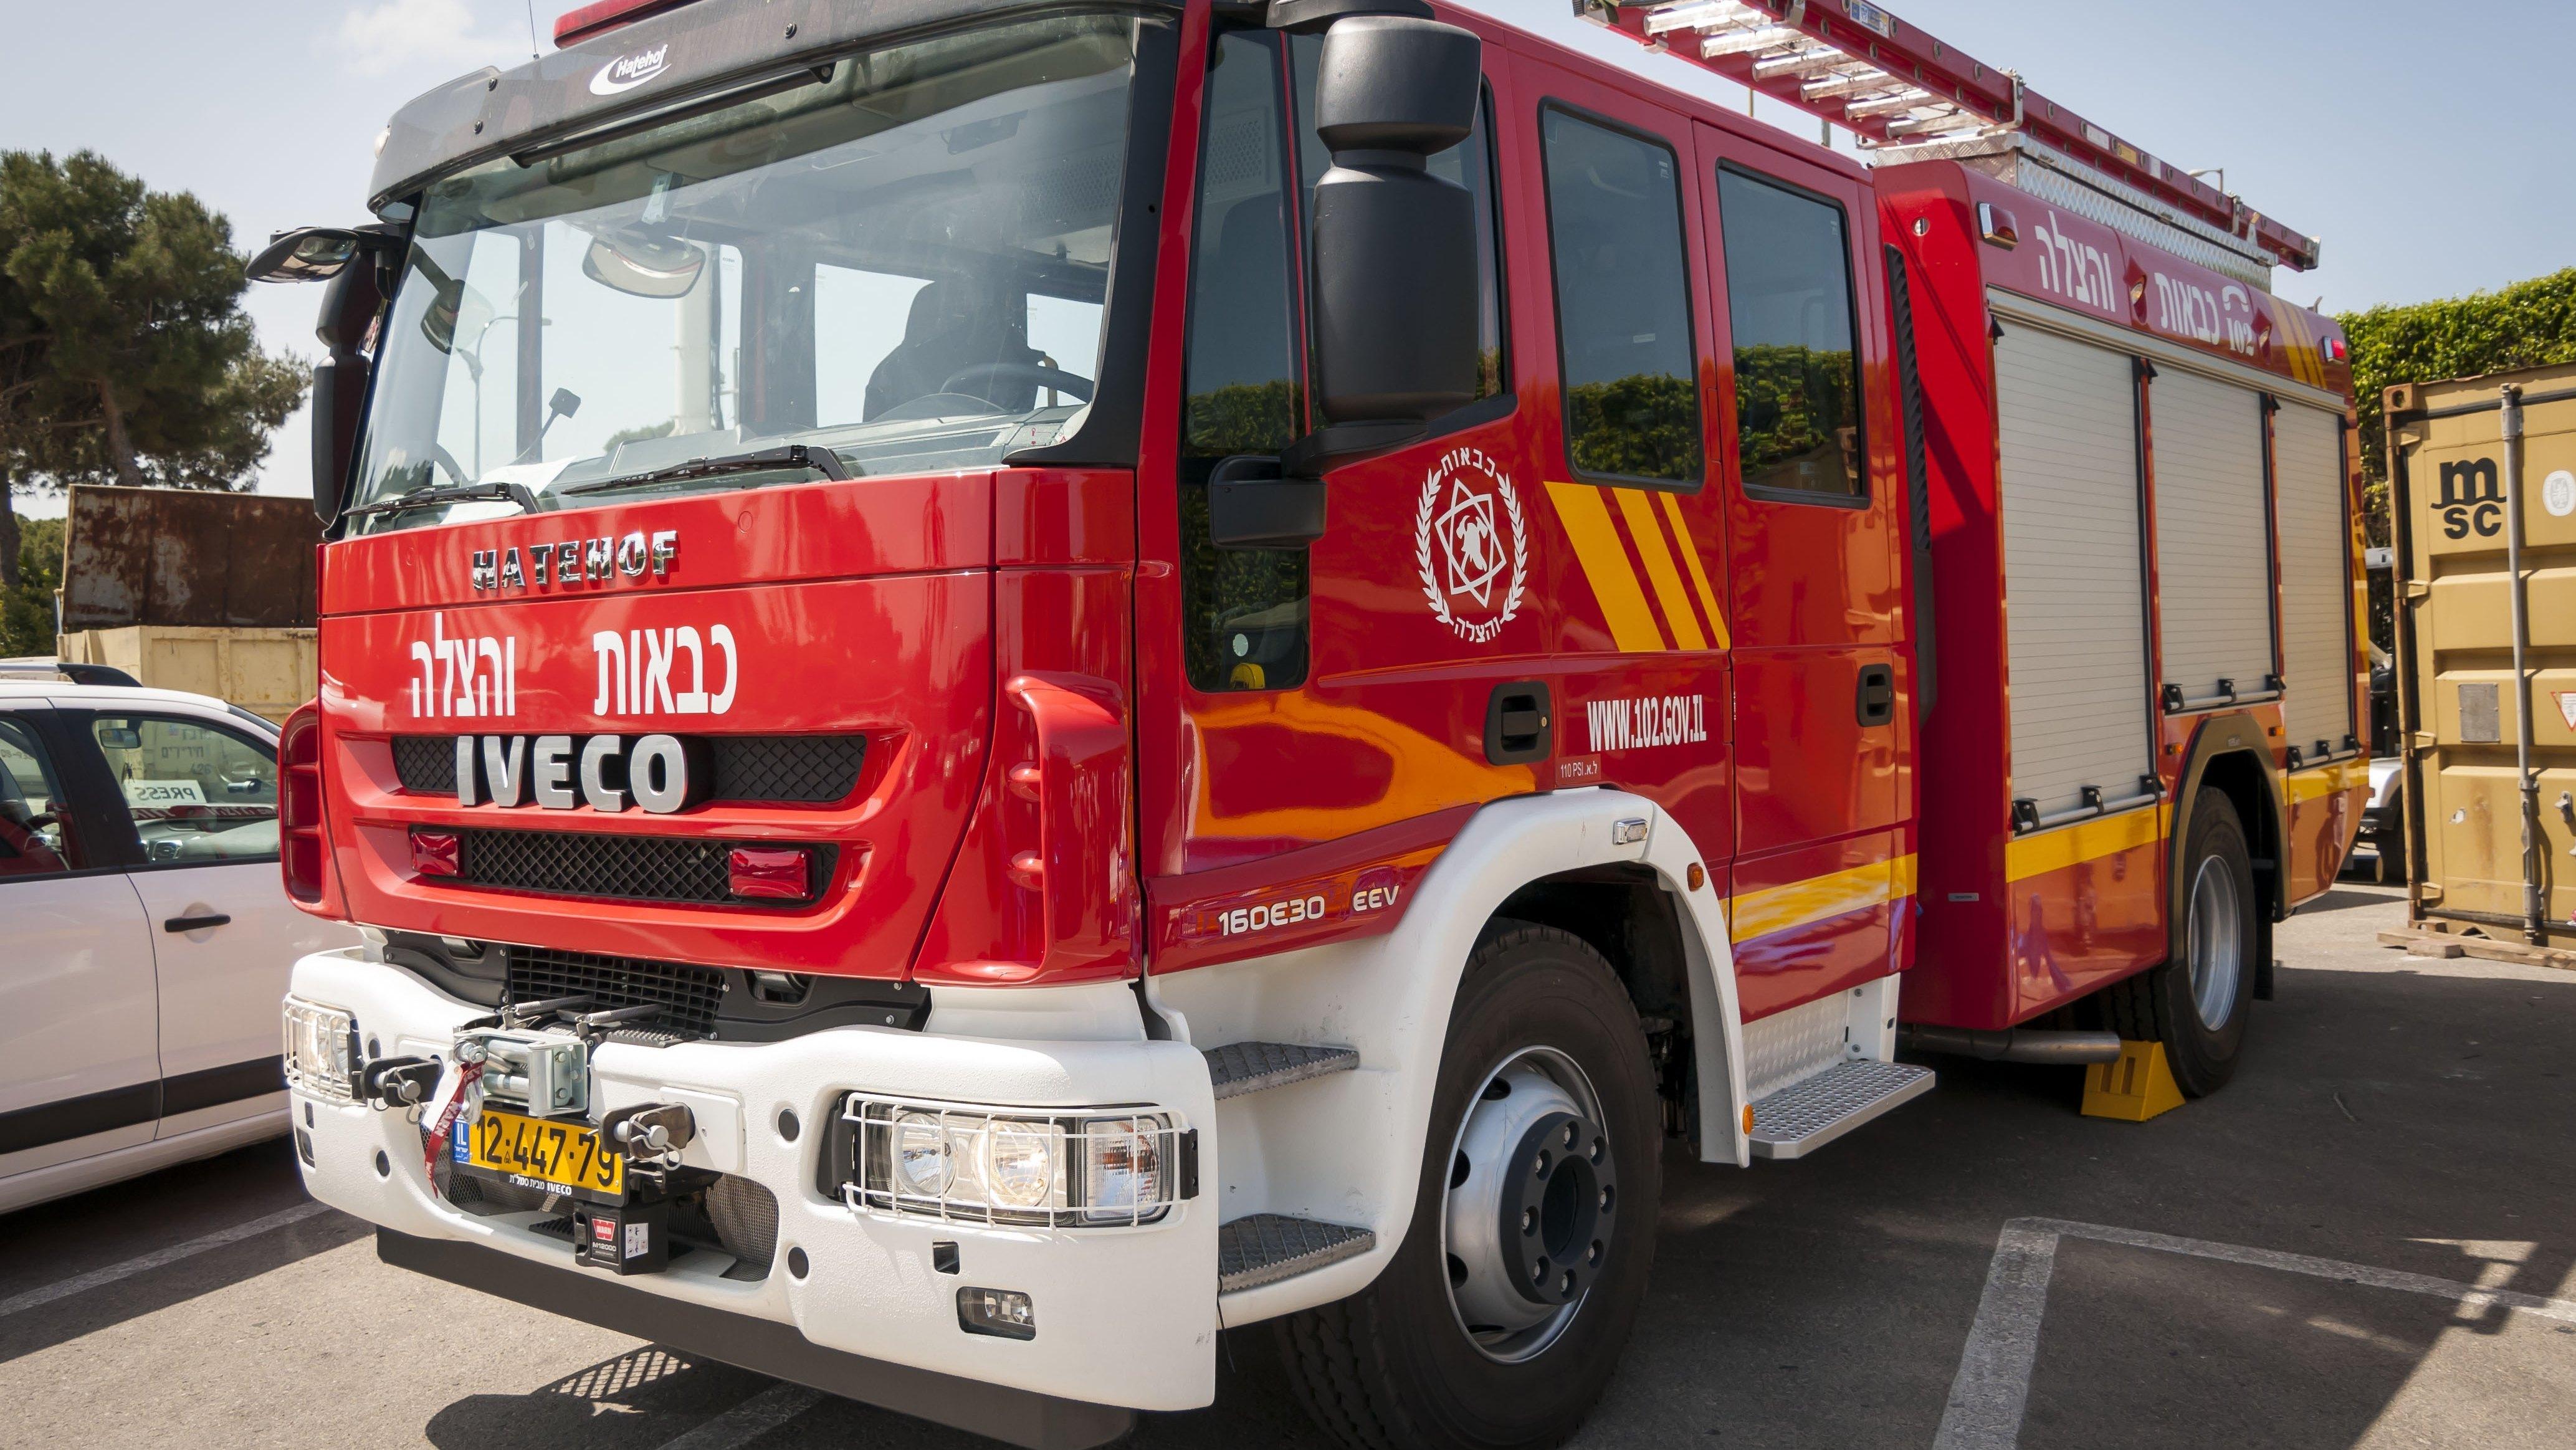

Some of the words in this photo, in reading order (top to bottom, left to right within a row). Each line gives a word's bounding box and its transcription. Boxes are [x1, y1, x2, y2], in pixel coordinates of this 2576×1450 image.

[616, 44, 669, 78] Hatehof
[2035, 210, 2116, 312] והצלה
[2154, 272, 2220, 345] כבאות
[2226, 317, 2254, 356] 102
[1441, 447, 1496, 477] כבאות
[472, 530, 677, 590] HATEHOF
[1454, 616, 1501, 642] והצלה
[412, 613, 515, 718] והצלה
[594, 624, 738, 716] כבאות
[1587, 694, 1707, 752] WWW.102.GOV.IL
[456, 734, 689, 814] IVECO
[1561, 763, 1572, 778] 110
[1573, 761, 1584, 777] PSI
[1218, 895, 1325, 936] 160E30
[1353, 885, 1400, 912] EEV
[546, 1182, 572, 1196] IVECO
